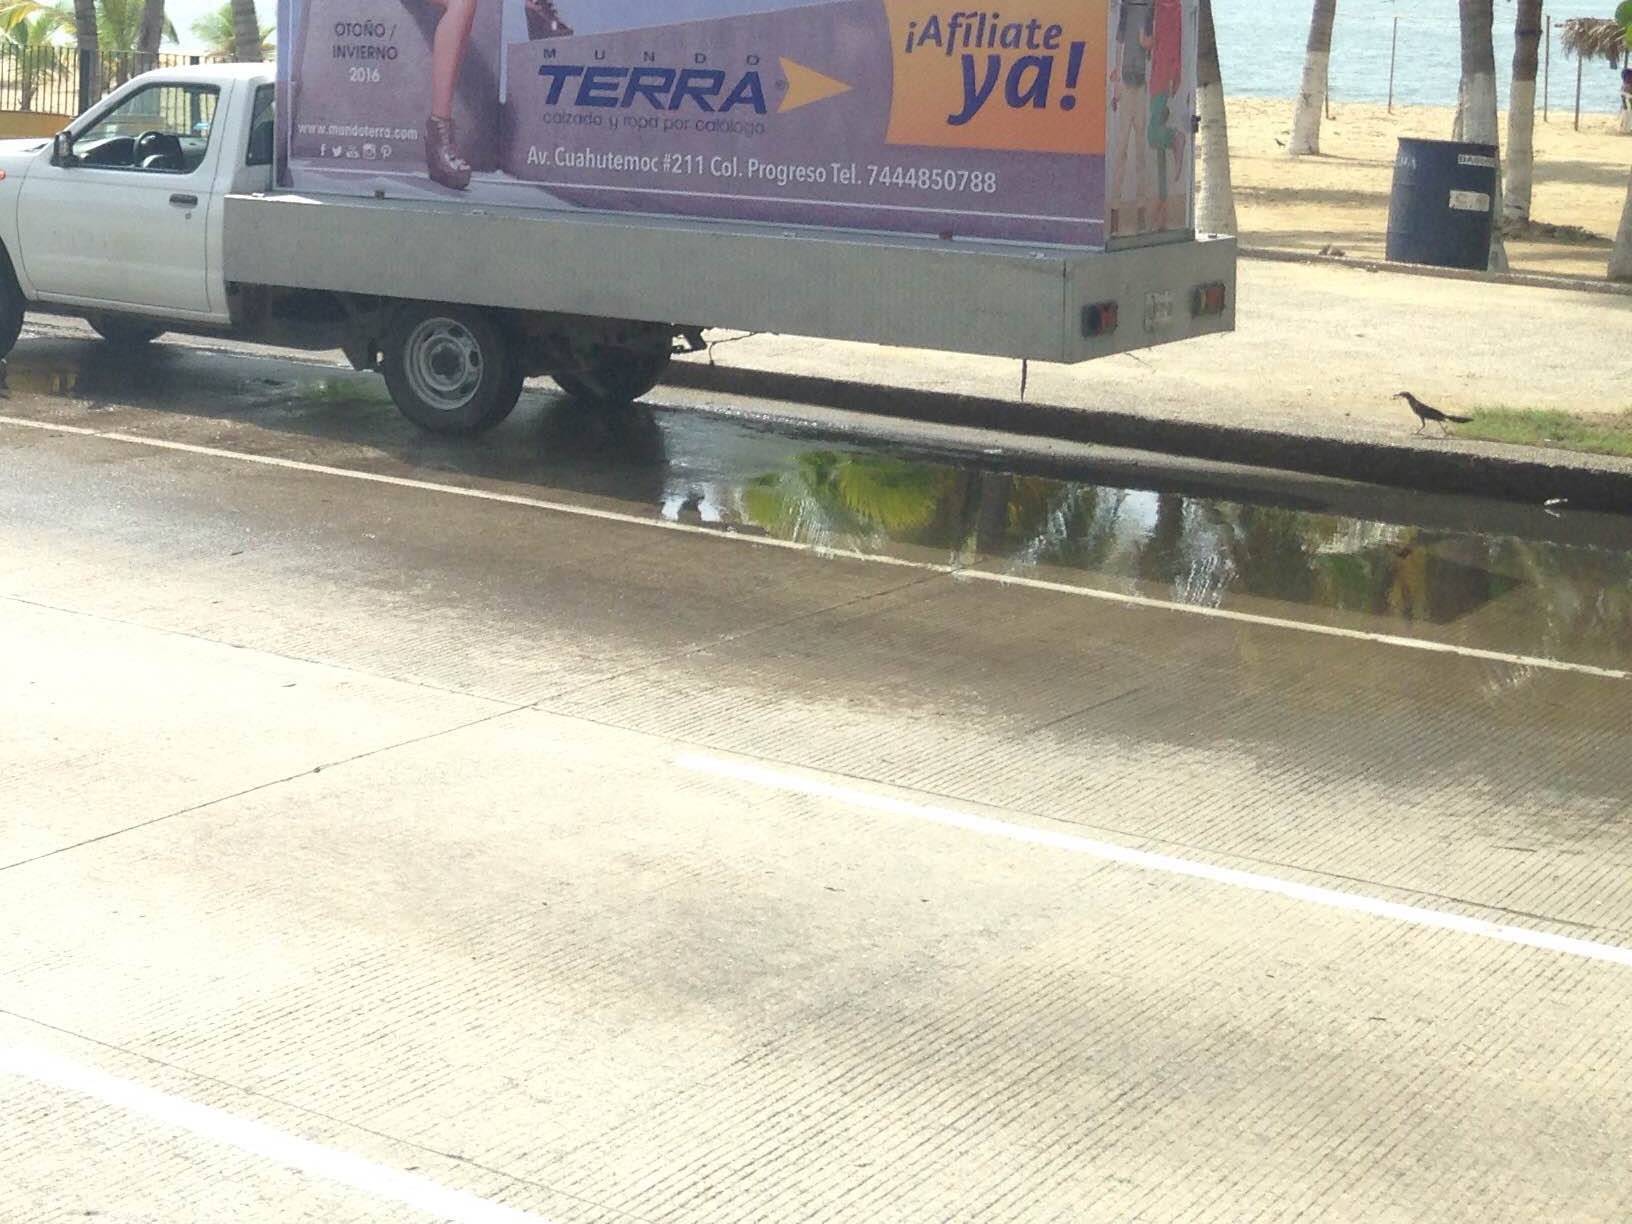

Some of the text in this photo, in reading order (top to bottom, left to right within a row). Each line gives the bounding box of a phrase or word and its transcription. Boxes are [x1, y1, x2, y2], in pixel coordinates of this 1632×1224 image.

[334, 20, 386, 38] OTOÑO
[332, 44, 399, 60] INVIERNO
[542, 47, 761, 66] MUNDO
[348, 66, 381, 83] 2016
[946, 41, 1087, 126] ya!
[538, 64, 768, 114] TERRA
[542, 110, 602, 126] calzado
[608, 116, 618, 129] y
[623, 115, 658, 130] ropa
[663, 118, 690, 133] por
[297, 123, 418, 140] www.mundoterra.com
[527, 146, 997, 193] Av. Cuahutemoc #211 Col. Progreso Tel. 7444850788
